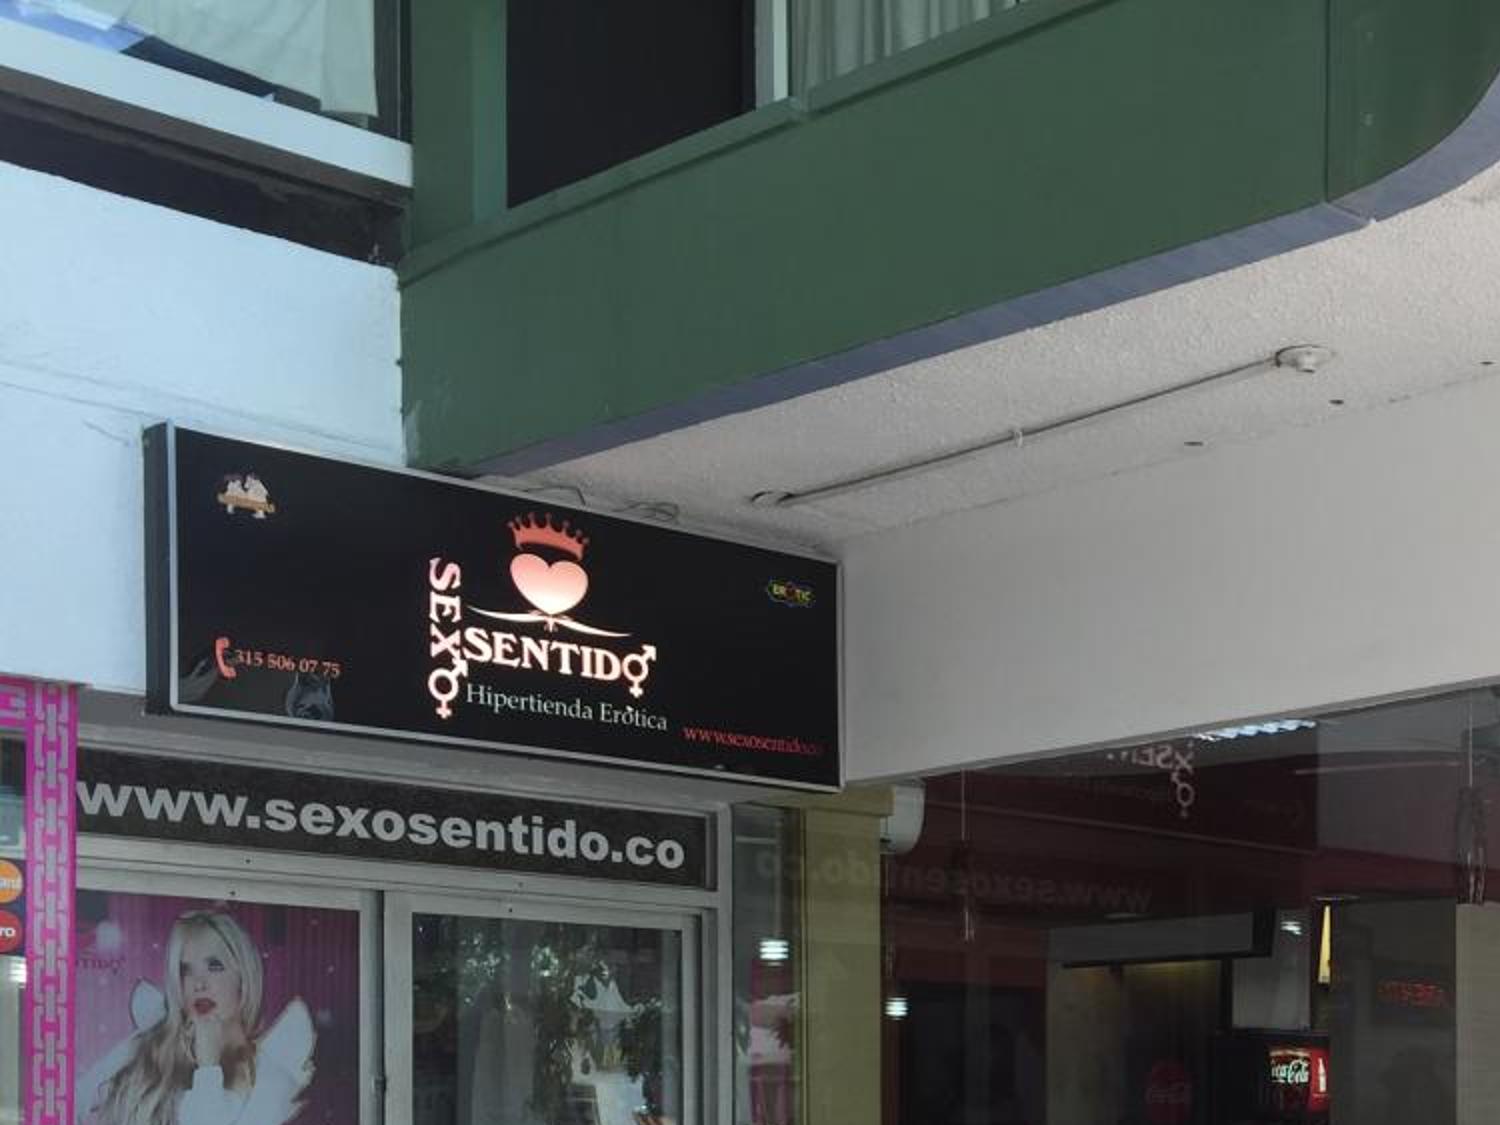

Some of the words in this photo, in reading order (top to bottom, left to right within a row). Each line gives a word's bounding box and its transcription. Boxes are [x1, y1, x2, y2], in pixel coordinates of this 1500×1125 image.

[235, 649, 263, 667] 315
[267, 653, 296, 671] 506
[299, 657, 318, 673] 07
[322, 661, 341, 678] 75
[428, 557, 466, 719] SEXO
[463, 626, 657, 698] SENTIDO
[466, 683, 593, 721] Hipertienda
[77, 780, 685, 869] www.sexosentido.co
